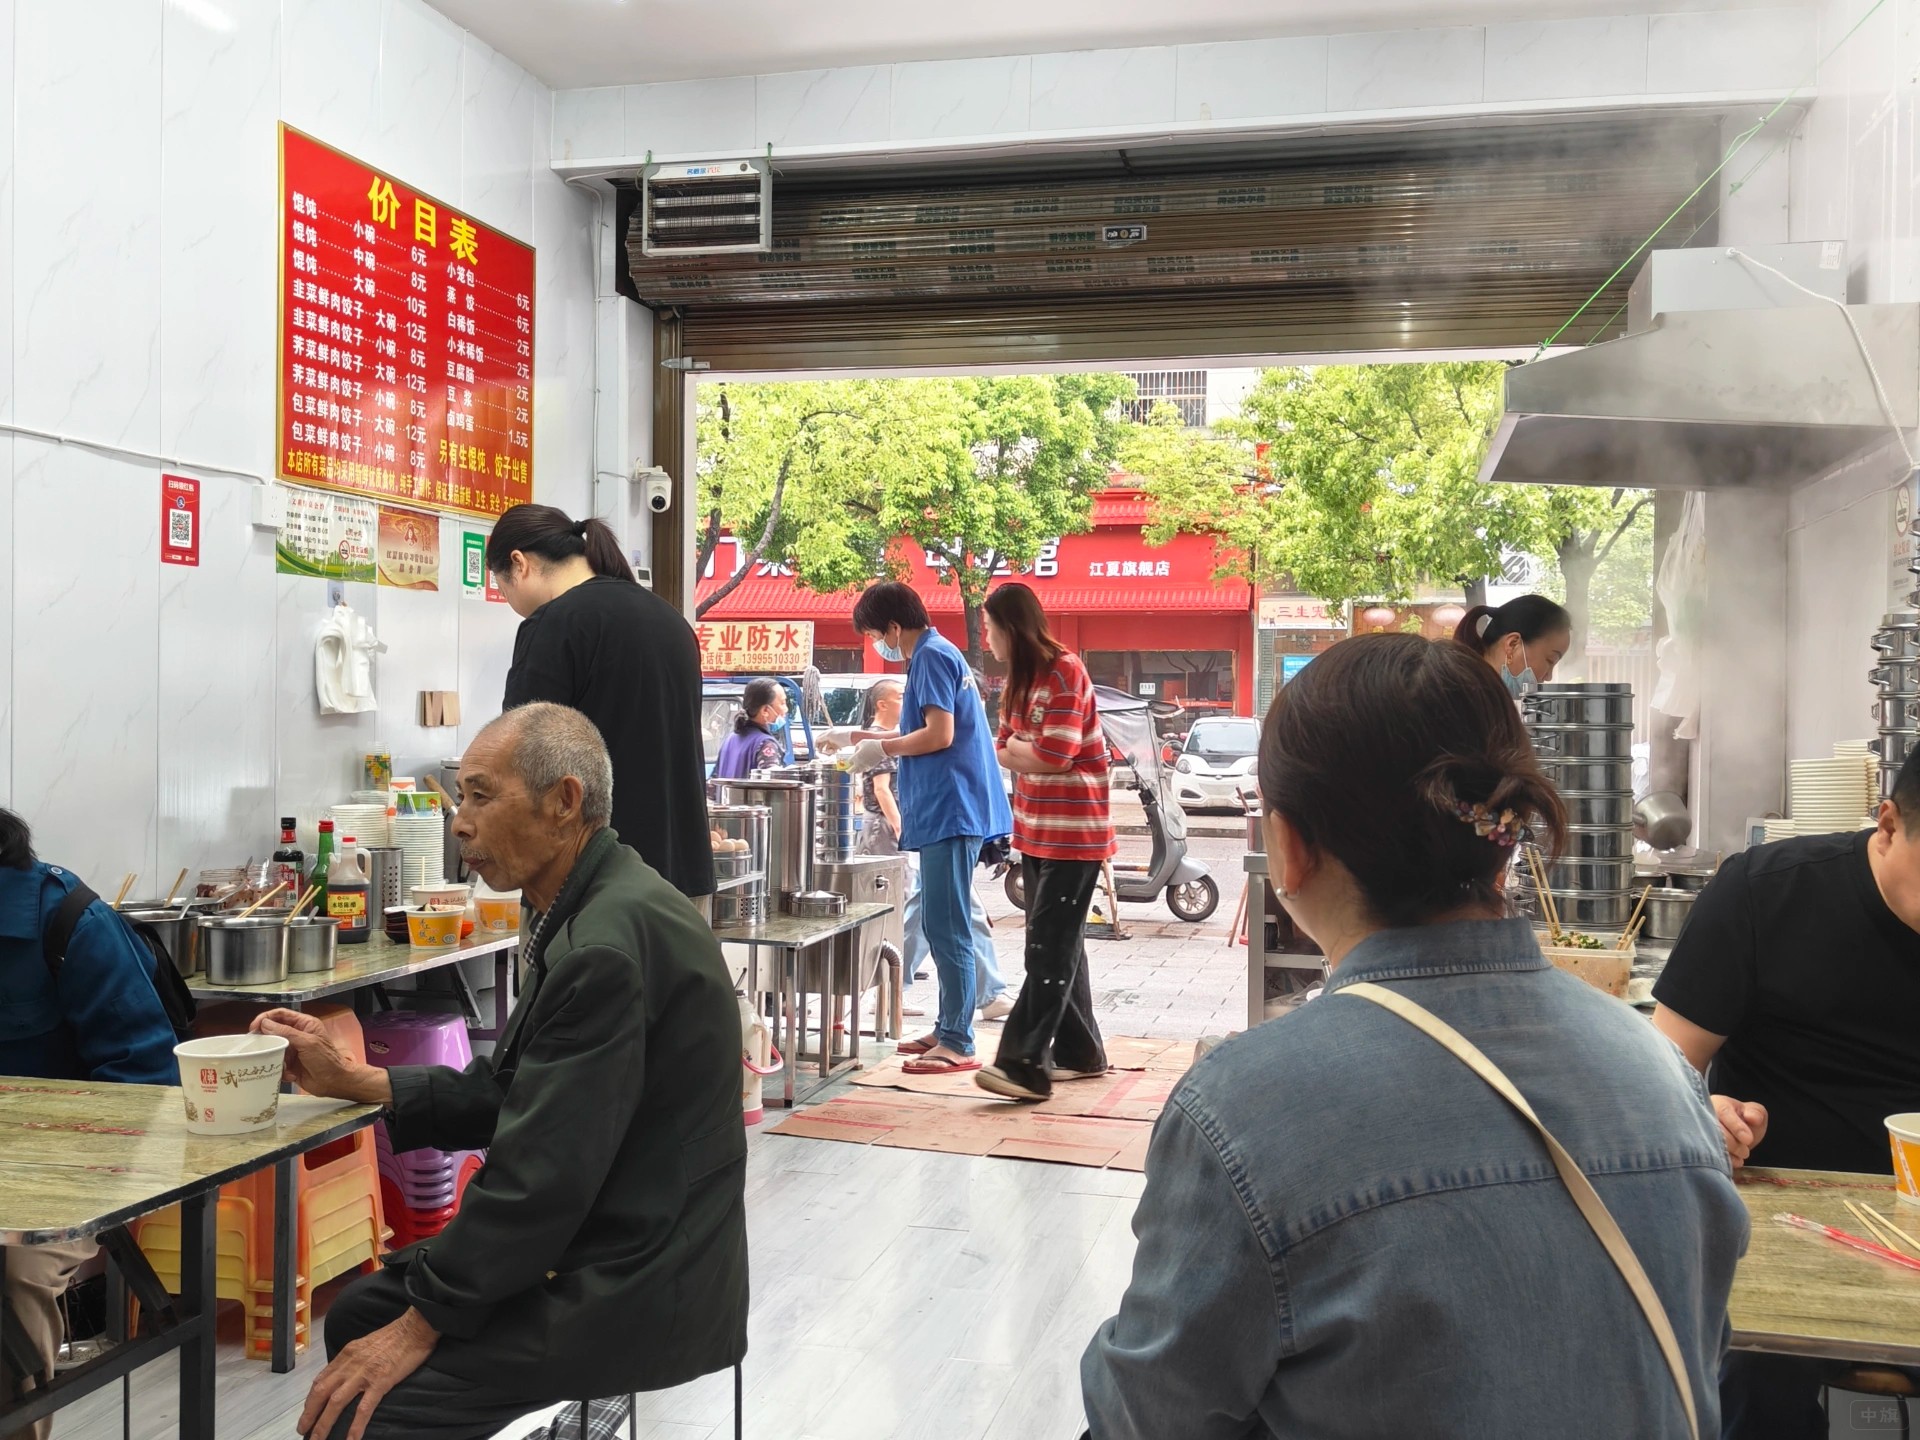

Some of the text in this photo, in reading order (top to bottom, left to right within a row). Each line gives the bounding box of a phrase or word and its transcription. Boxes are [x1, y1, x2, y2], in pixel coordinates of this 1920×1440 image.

[292, 191, 427, 267] 馄饨 小碗 6元
[368, 176, 478, 265] 价目表
[292, 220, 427, 292] 馄饨 中碗 8元
[292, 248, 427, 318] 馄饨 大碗 10元
[447, 262, 530, 311] 小笼包 6元
[292, 279, 427, 343] 韭菜鲜肉饺子 大碗 12元
[447, 311, 530, 357] 白稀饭 2元
[516, 317, 530, 335] 6元
[292, 307, 426, 368] 韭菜鲜肉饺子 小碗 8元
[447, 336, 530, 380] 小米稀饭 2元
[292, 335, 427, 394] 荠菜鲜肉饺子 大碗 12元
[446, 360, 529, 403] 豆腐脑 2元
[292, 363, 426, 419] 荠菜鲜肉饺子 小碗 8元
[516, 406, 529, 424] 2元
[292, 392, 427, 444] 包菜鲜肉饺子 大碗 12元
[446, 409, 529, 448] 卤鸡蛋 1.5元
[291, 421, 426, 469] 包菜鲜肉饺子 小碗 8元
[1089, 561, 1170, 577] 江夏旗舰店
[696, 624, 799, 651] 专业防水
